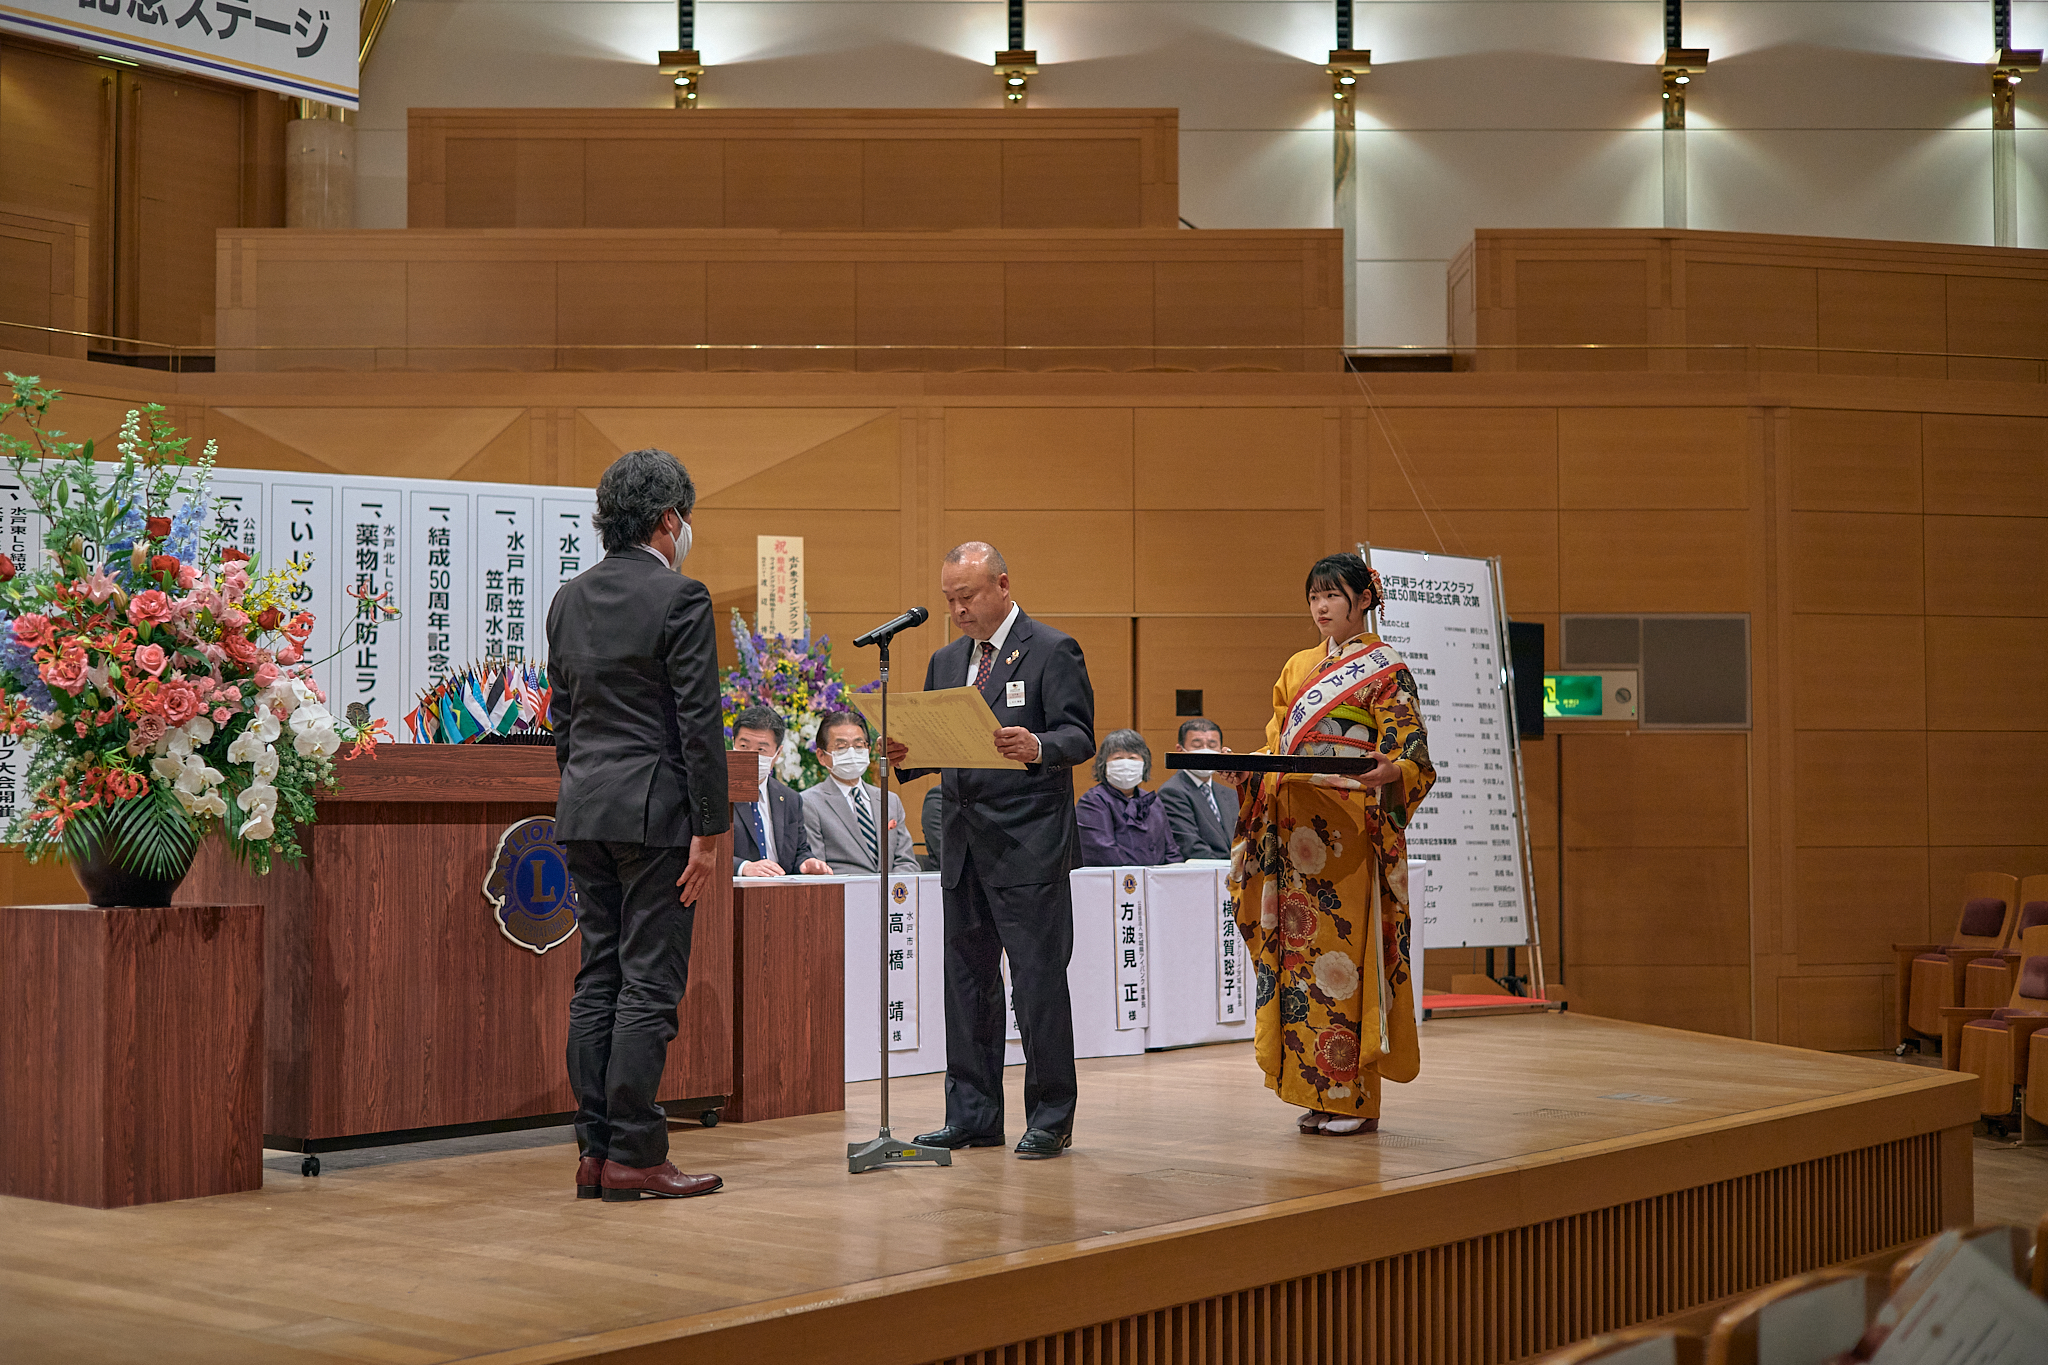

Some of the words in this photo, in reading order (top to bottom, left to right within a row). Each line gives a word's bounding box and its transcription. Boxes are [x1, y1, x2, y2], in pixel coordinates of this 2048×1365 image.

[10, 507, 27, 579] 水戸東LC結成
[559, 513, 580, 583] 一、水戸
[507, 530, 525, 665] 水戸市笠原町
[1383, 575, 1474, 594] 水戸東ライオンズクラブ
[531, 860, 556, 902] L
[513, 917, 570, 938] INTERNATIONAL
[889, 912, 904, 971] 高橋
[906, 911, 914, 959] 水戸市長
[1120, 902, 1137, 968] 方波見
[889, 1001, 904, 1022] 靖
[1124, 983, 1138, 1002] 正
[892, 1030, 902, 1042] 様
[1128, 1010, 1136, 1021] 様
